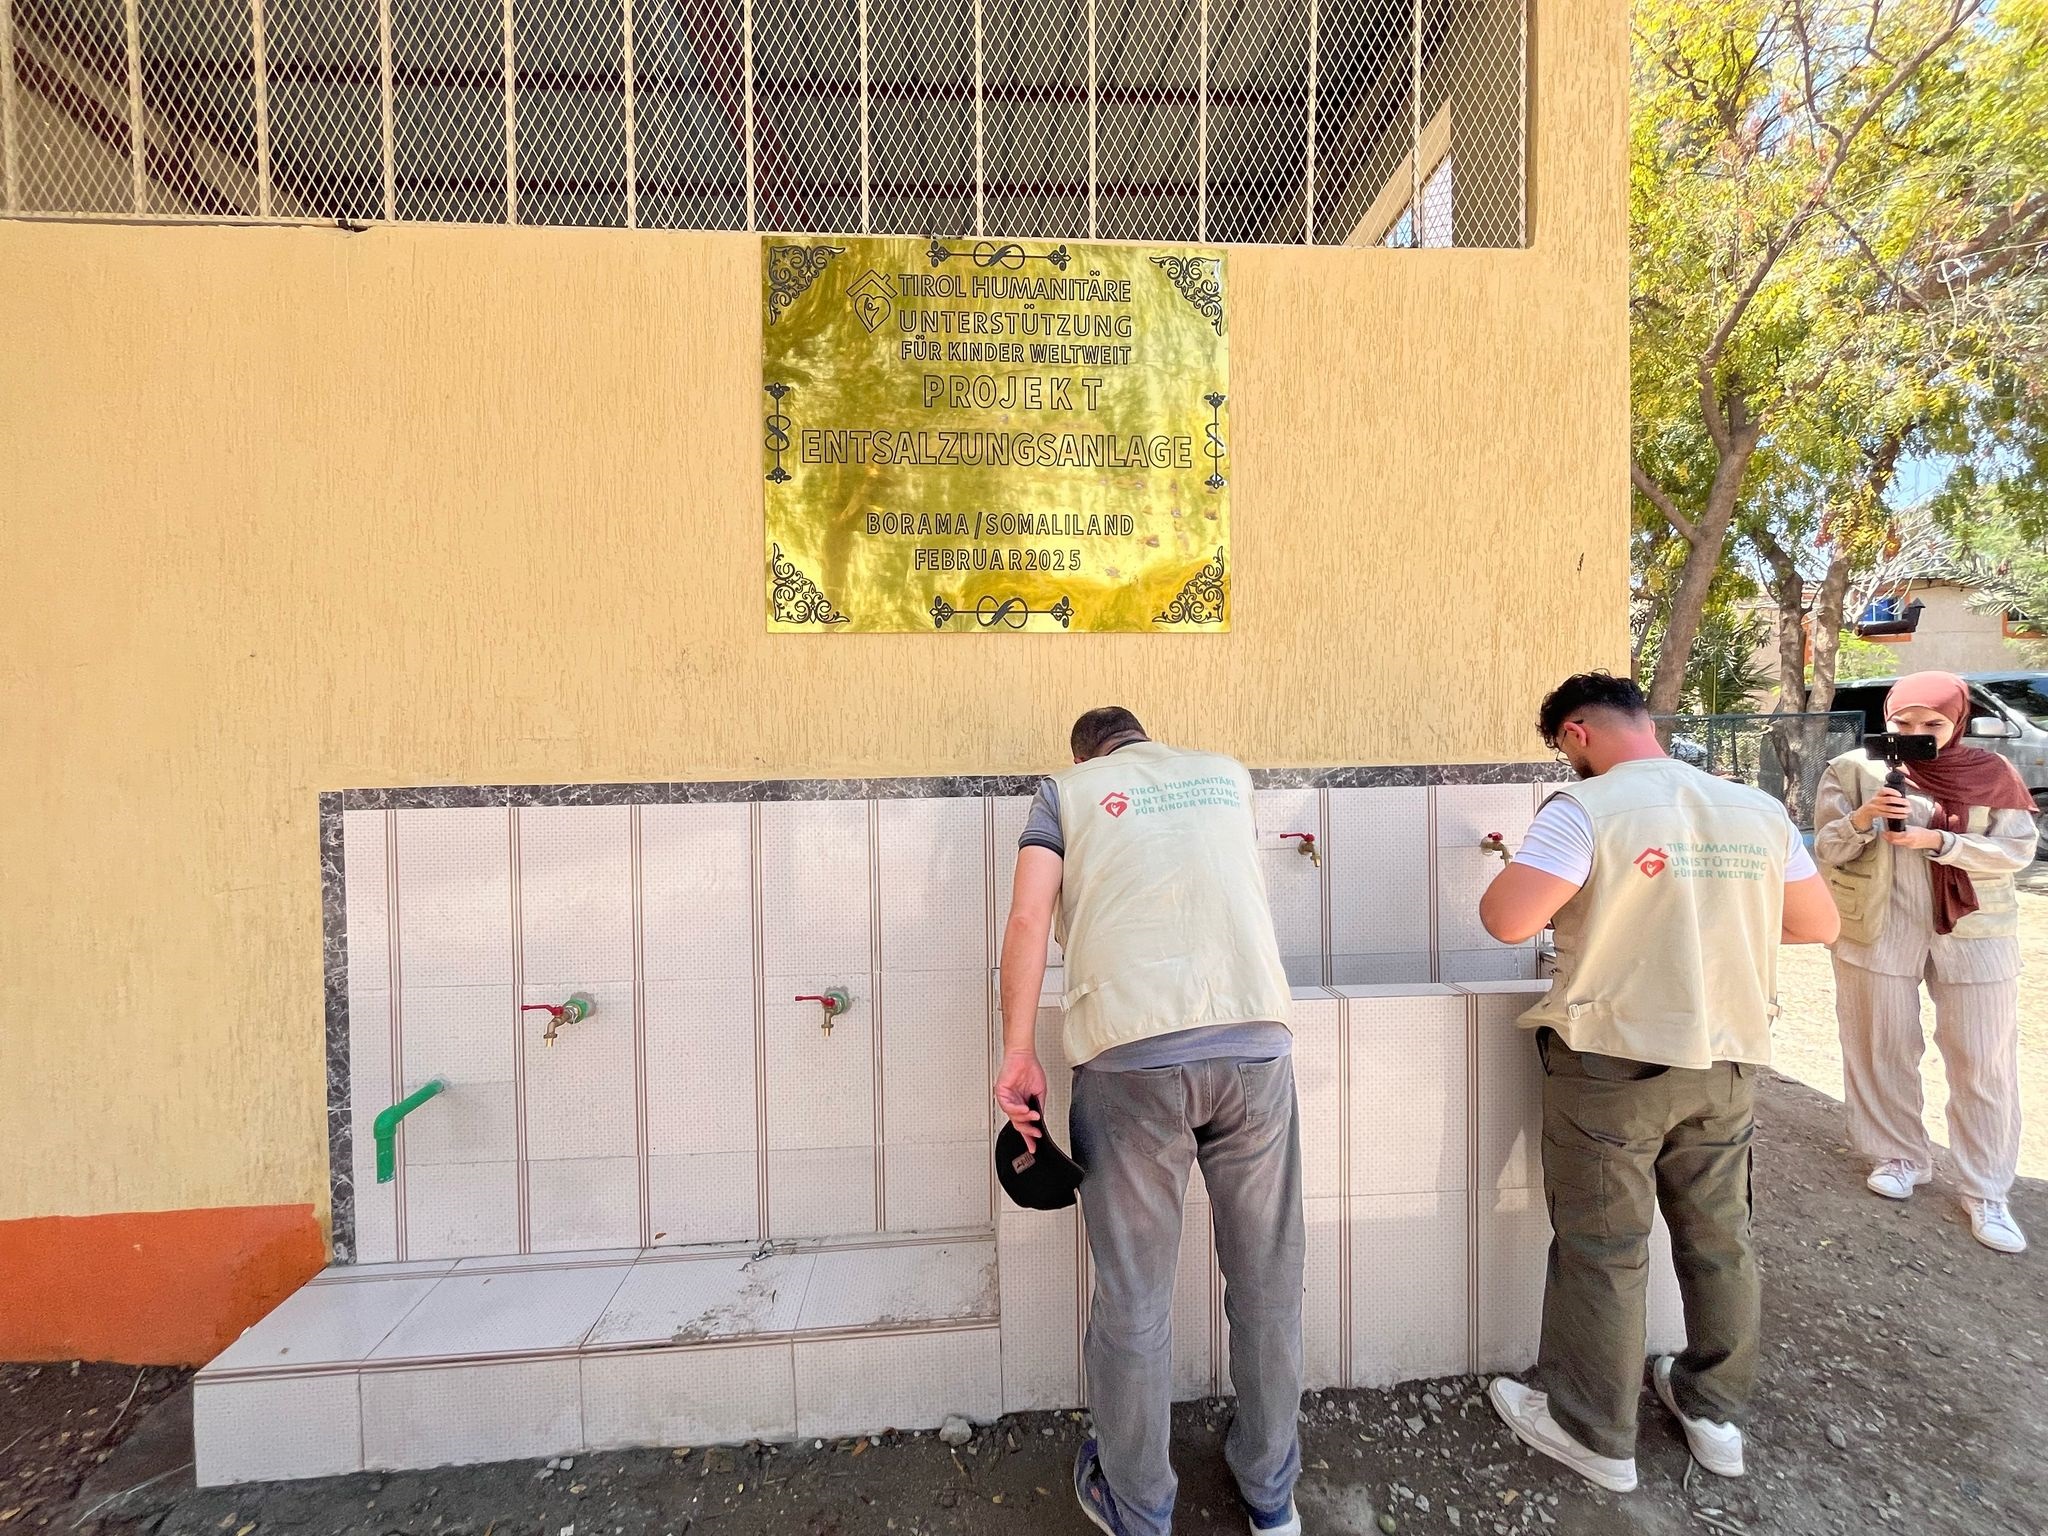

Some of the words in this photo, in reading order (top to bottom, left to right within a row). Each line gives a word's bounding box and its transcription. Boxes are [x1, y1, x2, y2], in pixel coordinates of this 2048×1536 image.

[898, 273, 967, 299] TIROL
[971, 270, 1132, 302] HUMANITÄRE
[899, 303, 1132, 337] UNTERSTÜTZUNG
[901, 334, 942, 361] FÜR
[947, 341, 1025, 363] KINDER
[1029, 343, 1132, 366] WELTWEIT
[923, 374, 1104, 411] PROJEKT
[801, 429, 1193, 469] ENTSALZUNGSANLAGE
[1129, 785, 1162, 795] TIROL
[1135, 806, 1155, 815] FÜR
[1157, 800, 1196, 812] KINDER
